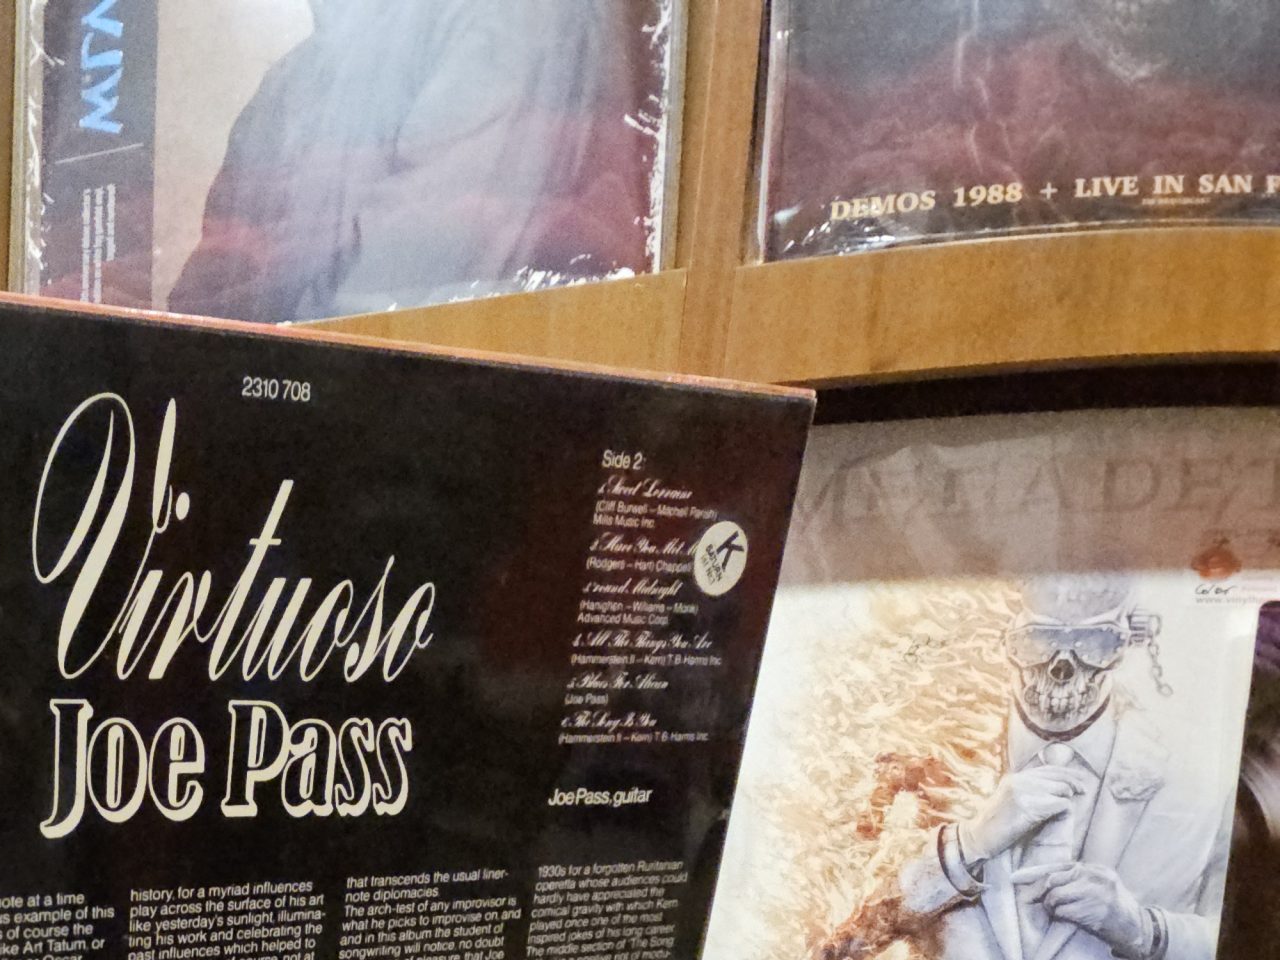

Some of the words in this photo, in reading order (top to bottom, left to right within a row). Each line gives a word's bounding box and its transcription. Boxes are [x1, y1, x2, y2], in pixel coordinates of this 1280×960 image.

[830, 189, 936, 221] DEMOS
[953, 182, 1023, 207] 1988
[1039, 182, 1058, 200] +
[1074, 175, 1139, 198] LIVE
[1152, 175, 1185, 195] IN
[1199, 173, 1253, 194] SAN
[241, 376, 278, 400] 2310
[282, 379, 312, 402] 708
[602, 450, 631, 468] Side
[32, 391, 436, 683] Virtuoso
[40, 698, 205, 839] Joe
[220, 699, 412, 818] Pass
[548, 788, 572, 806] Joe
[613, 787, 653, 807] guitar
[27, 894, 40, 907] at
[44, 895, 52, 906] a
[178, 887, 193, 899] for
[197, 887, 205, 898] a
[209, 883, 250, 900] myriad
[253, 881, 313, 895] influences
